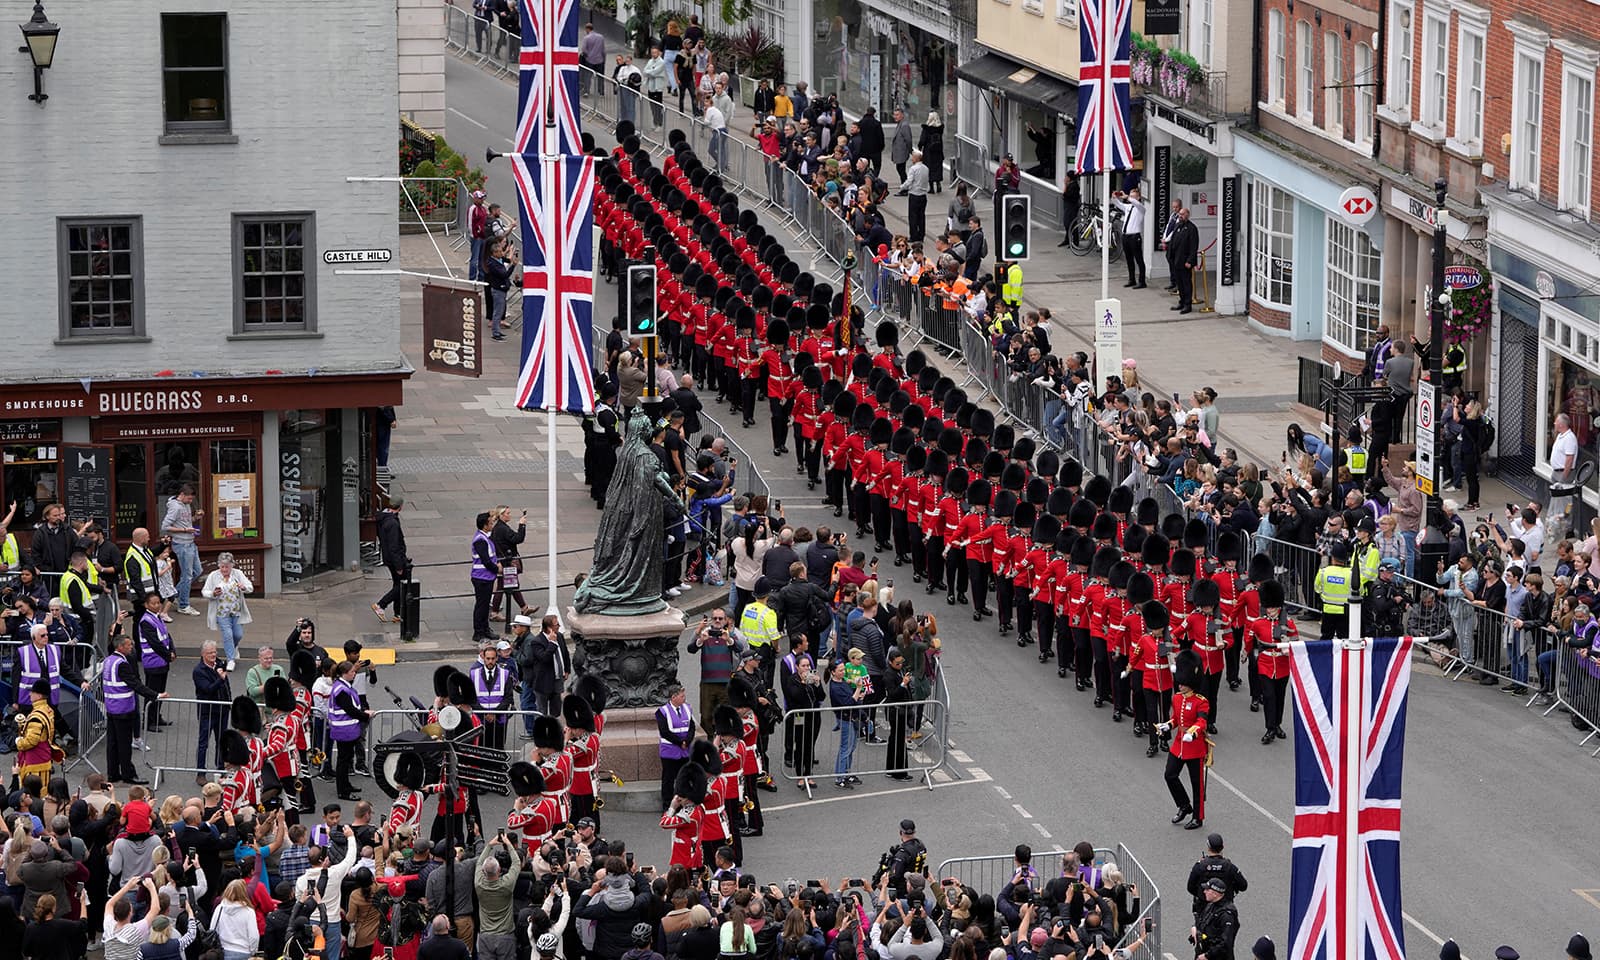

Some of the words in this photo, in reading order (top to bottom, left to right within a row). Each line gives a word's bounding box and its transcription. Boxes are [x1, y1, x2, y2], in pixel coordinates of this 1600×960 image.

[1159, 149, 1167, 188] WINDSOR
[1224, 179, 1233, 221] WINDSOR
[1409, 197, 1427, 221] HSBC
[326, 251, 363, 261] CASTLE
[367, 251, 388, 260] HILL
[1223, 221, 1233, 278] MACDONALD
[1445, 274, 1480, 284] RITAIN
[463, 297, 475, 369] BLUEGRASS
[6, 399, 84, 410] SMOKEHOUSE
[99, 391, 202, 412] BLUEGRASS
[217, 394, 253, 404] B.B.Q.
[151, 427, 187, 435] SOUTHERN
[190, 426, 235, 434] SMOKEHOUSE
[282, 452, 302, 574] BLUEGRASS
